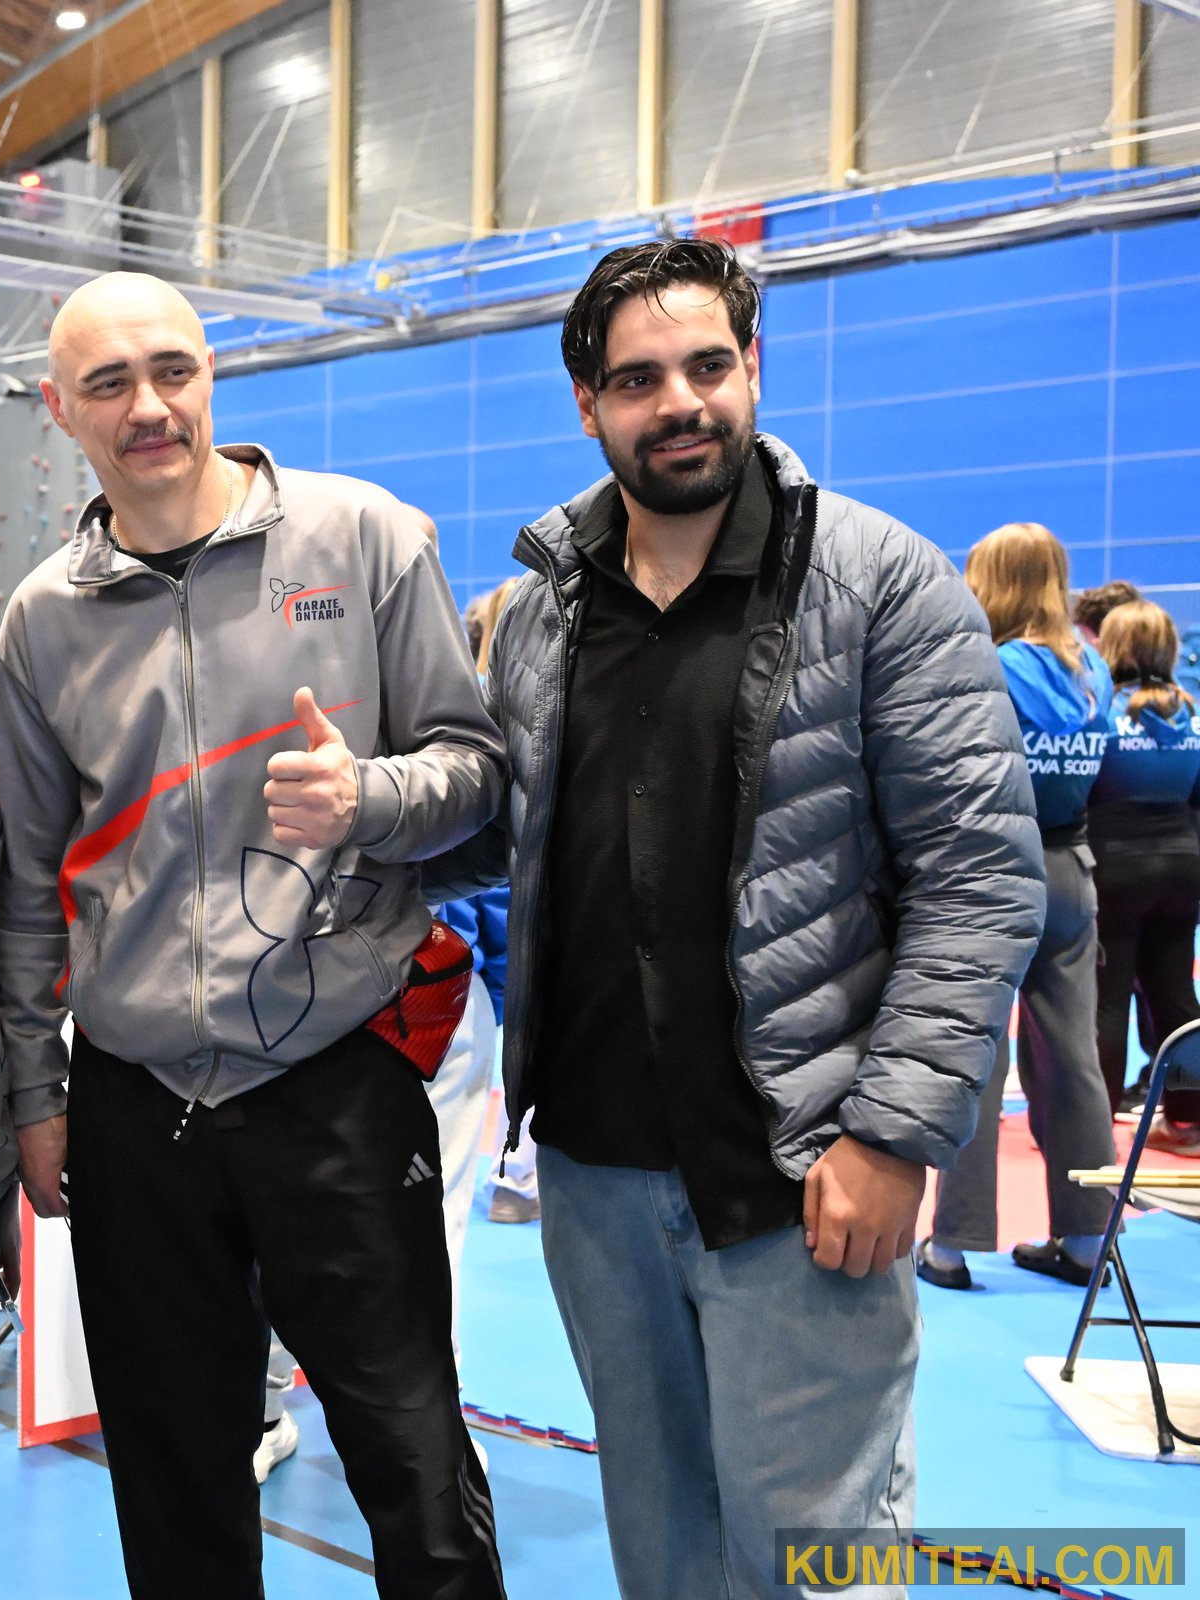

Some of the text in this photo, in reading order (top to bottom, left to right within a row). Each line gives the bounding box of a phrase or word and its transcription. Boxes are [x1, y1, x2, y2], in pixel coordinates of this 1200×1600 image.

[295, 598, 339, 611] KARATE
[295, 608, 344, 621] ONTARIO
[1027, 758, 1060, 774] OVA
